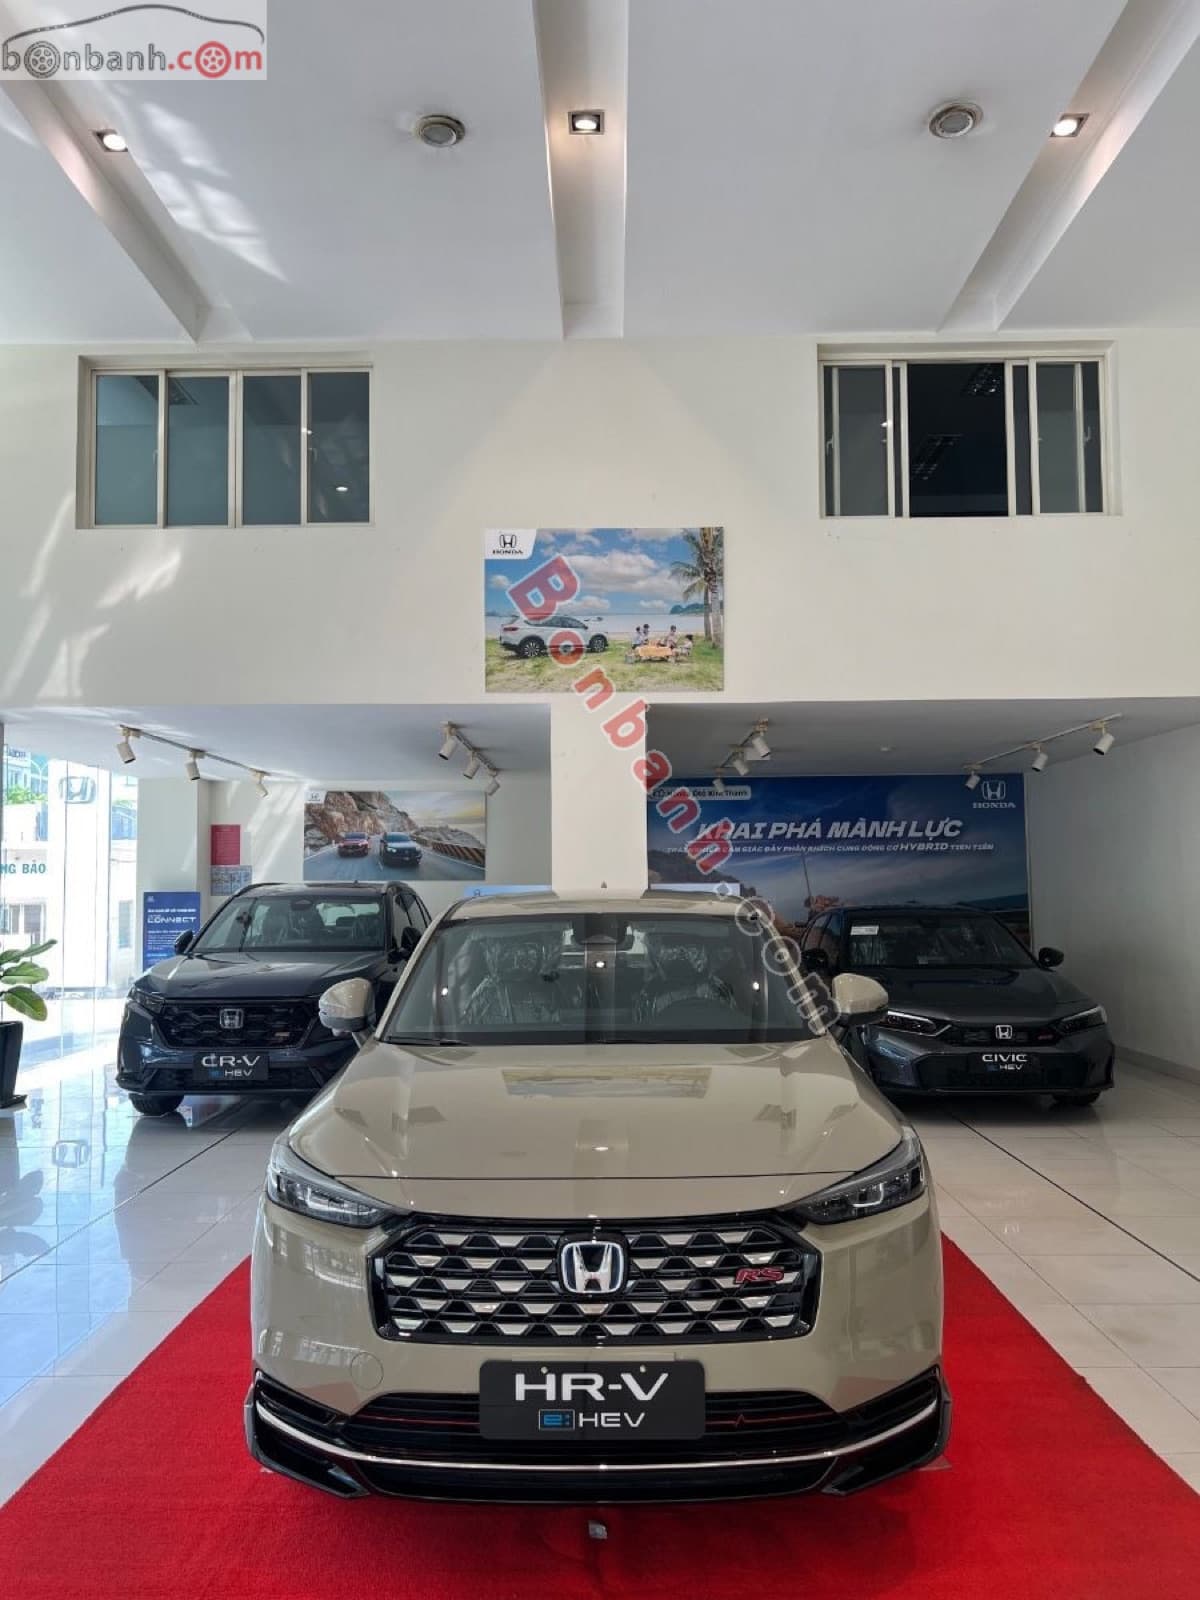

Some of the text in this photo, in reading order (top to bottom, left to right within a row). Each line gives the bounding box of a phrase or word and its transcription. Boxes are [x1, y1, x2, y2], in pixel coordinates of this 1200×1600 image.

[768, 818, 823, 840] PHÁ
[908, 817, 963, 841] LỰC
[899, 842, 949, 851] HYBRID
[202, 1054, 260, 1068] CR-V
[982, 1054, 1027, 1062] CIVIC
[735, 1266, 785, 1284] RS
[515, 1373, 669, 1401] HR-V
